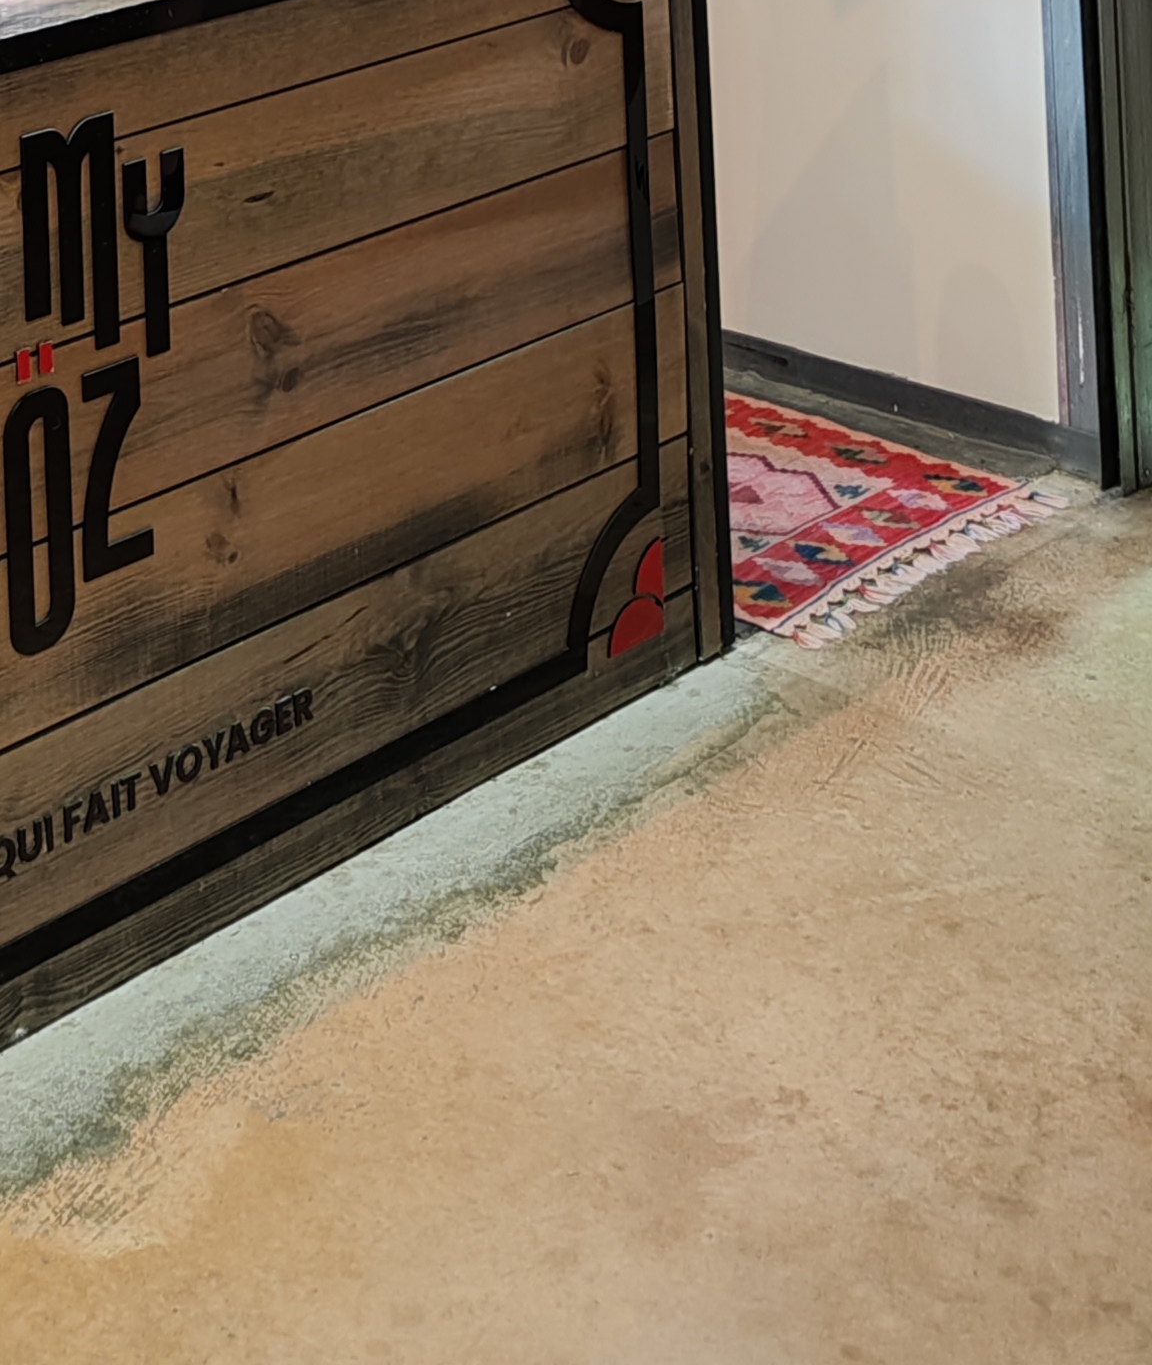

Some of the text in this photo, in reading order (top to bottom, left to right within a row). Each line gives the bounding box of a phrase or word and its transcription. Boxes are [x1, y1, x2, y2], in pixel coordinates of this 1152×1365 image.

[20, 110, 185, 358] MY
[62, 772, 142, 845] FAIT
[148, 686, 315, 798] VOYAGER
